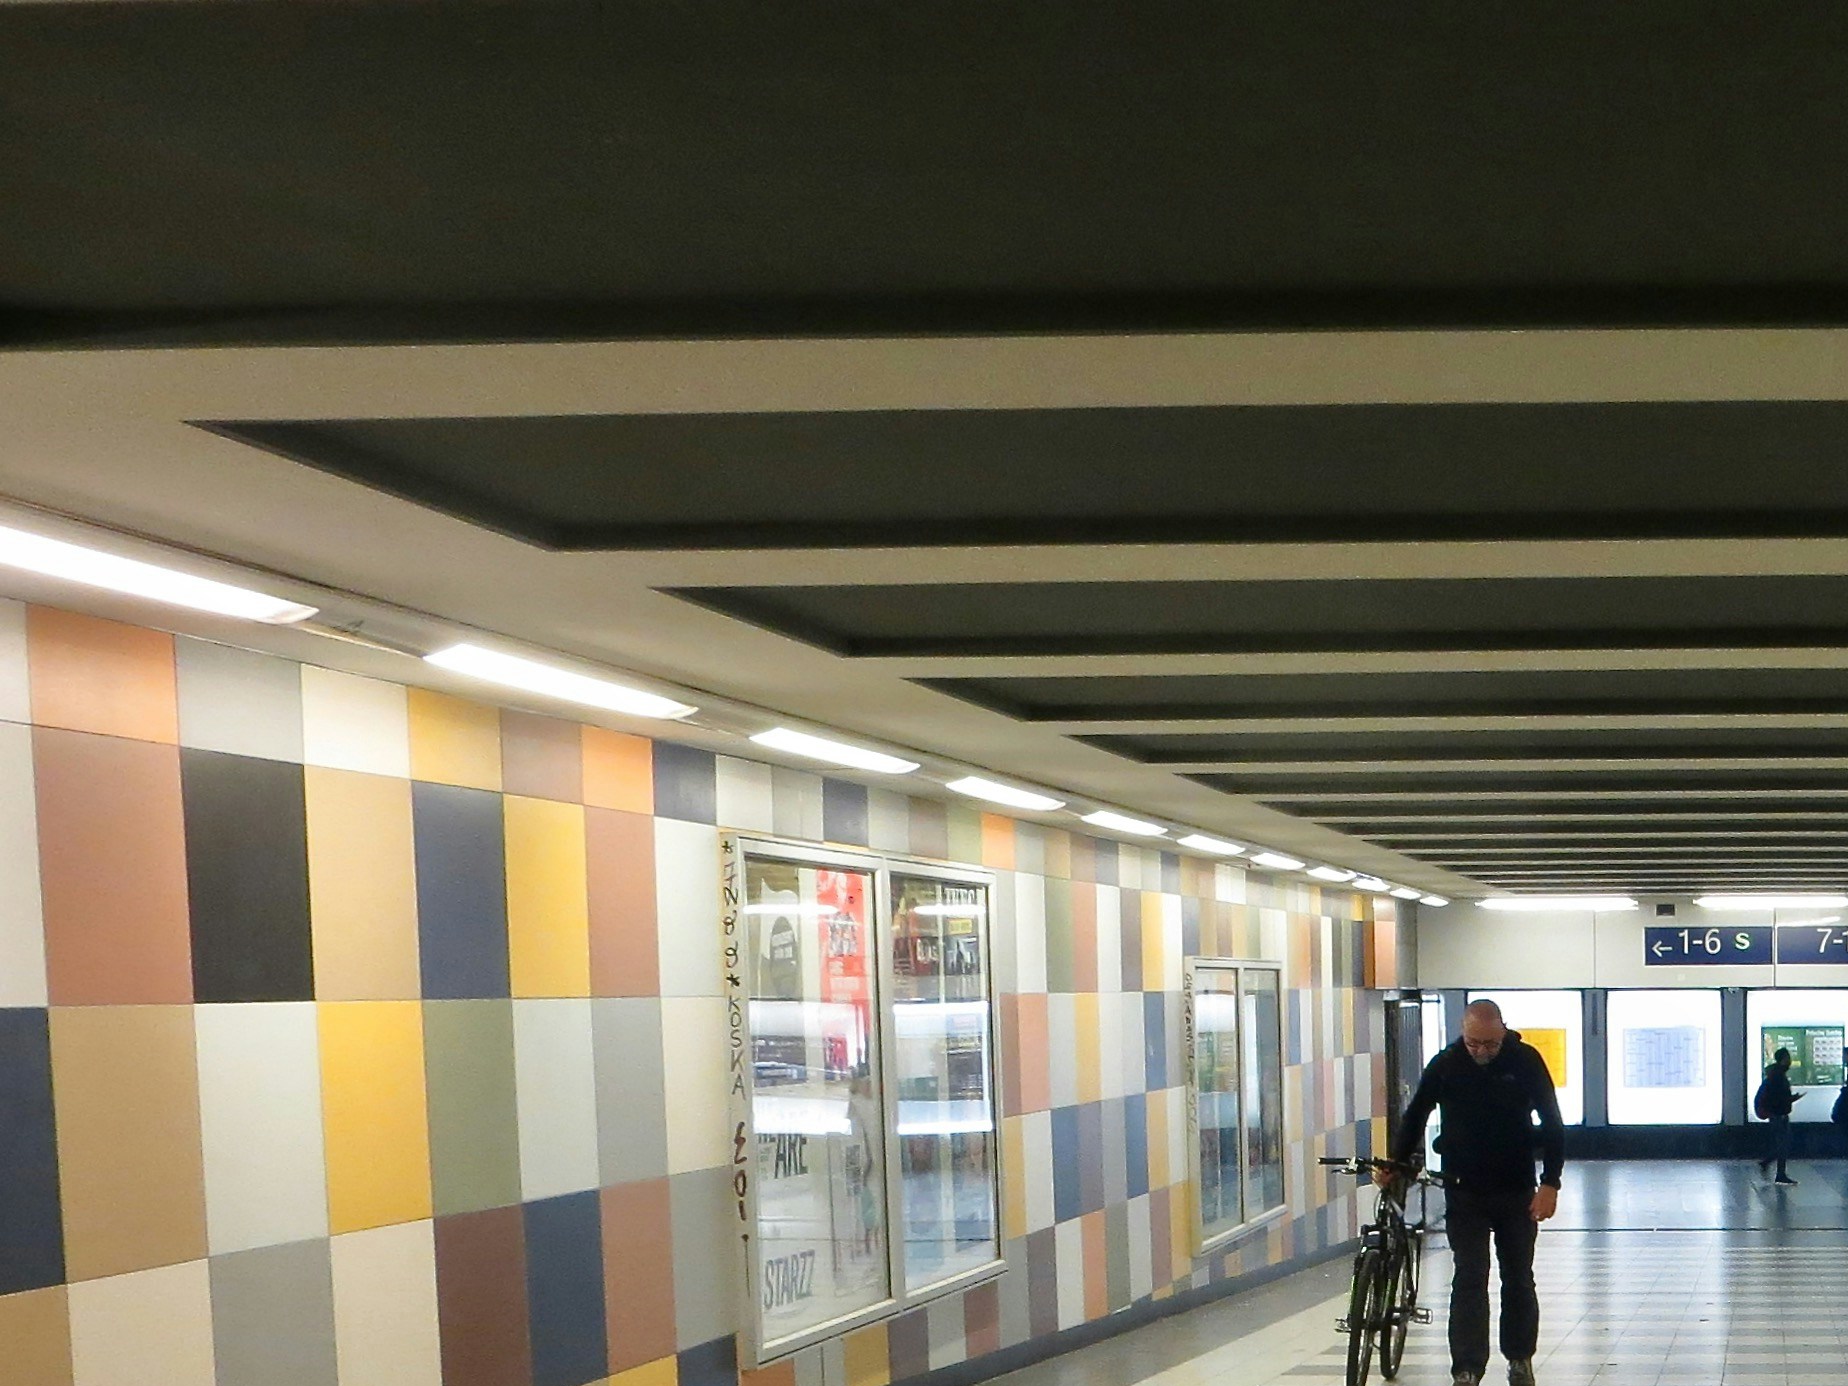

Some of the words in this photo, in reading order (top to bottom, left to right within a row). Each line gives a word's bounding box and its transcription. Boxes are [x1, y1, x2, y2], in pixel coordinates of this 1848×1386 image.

[1678, 929, 1722, 954] 1-6
[1735, 931, 1751, 950] S
[728, 995, 746, 1101] KOSKA
